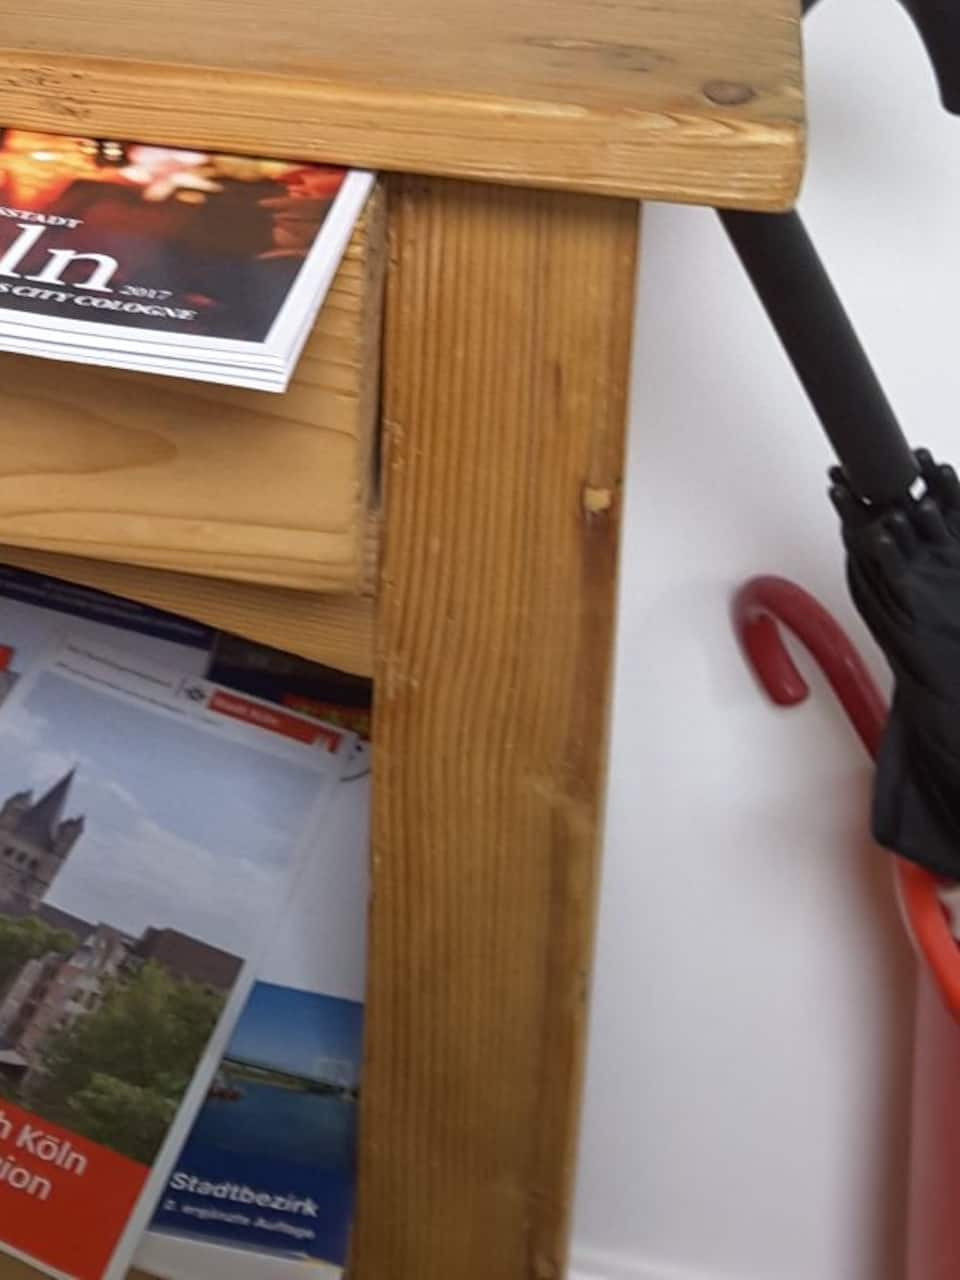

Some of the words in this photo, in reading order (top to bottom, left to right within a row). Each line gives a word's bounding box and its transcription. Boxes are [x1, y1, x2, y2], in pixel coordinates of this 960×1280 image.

[11, 285, 76, 303] CITY
[74, 294, 200, 321] COLOGNE
[118, 284, 173, 301] 2017
[15, 1123, 88, 1176] Köln
[168, 1170, 321, 1218] Stadtbezirk
